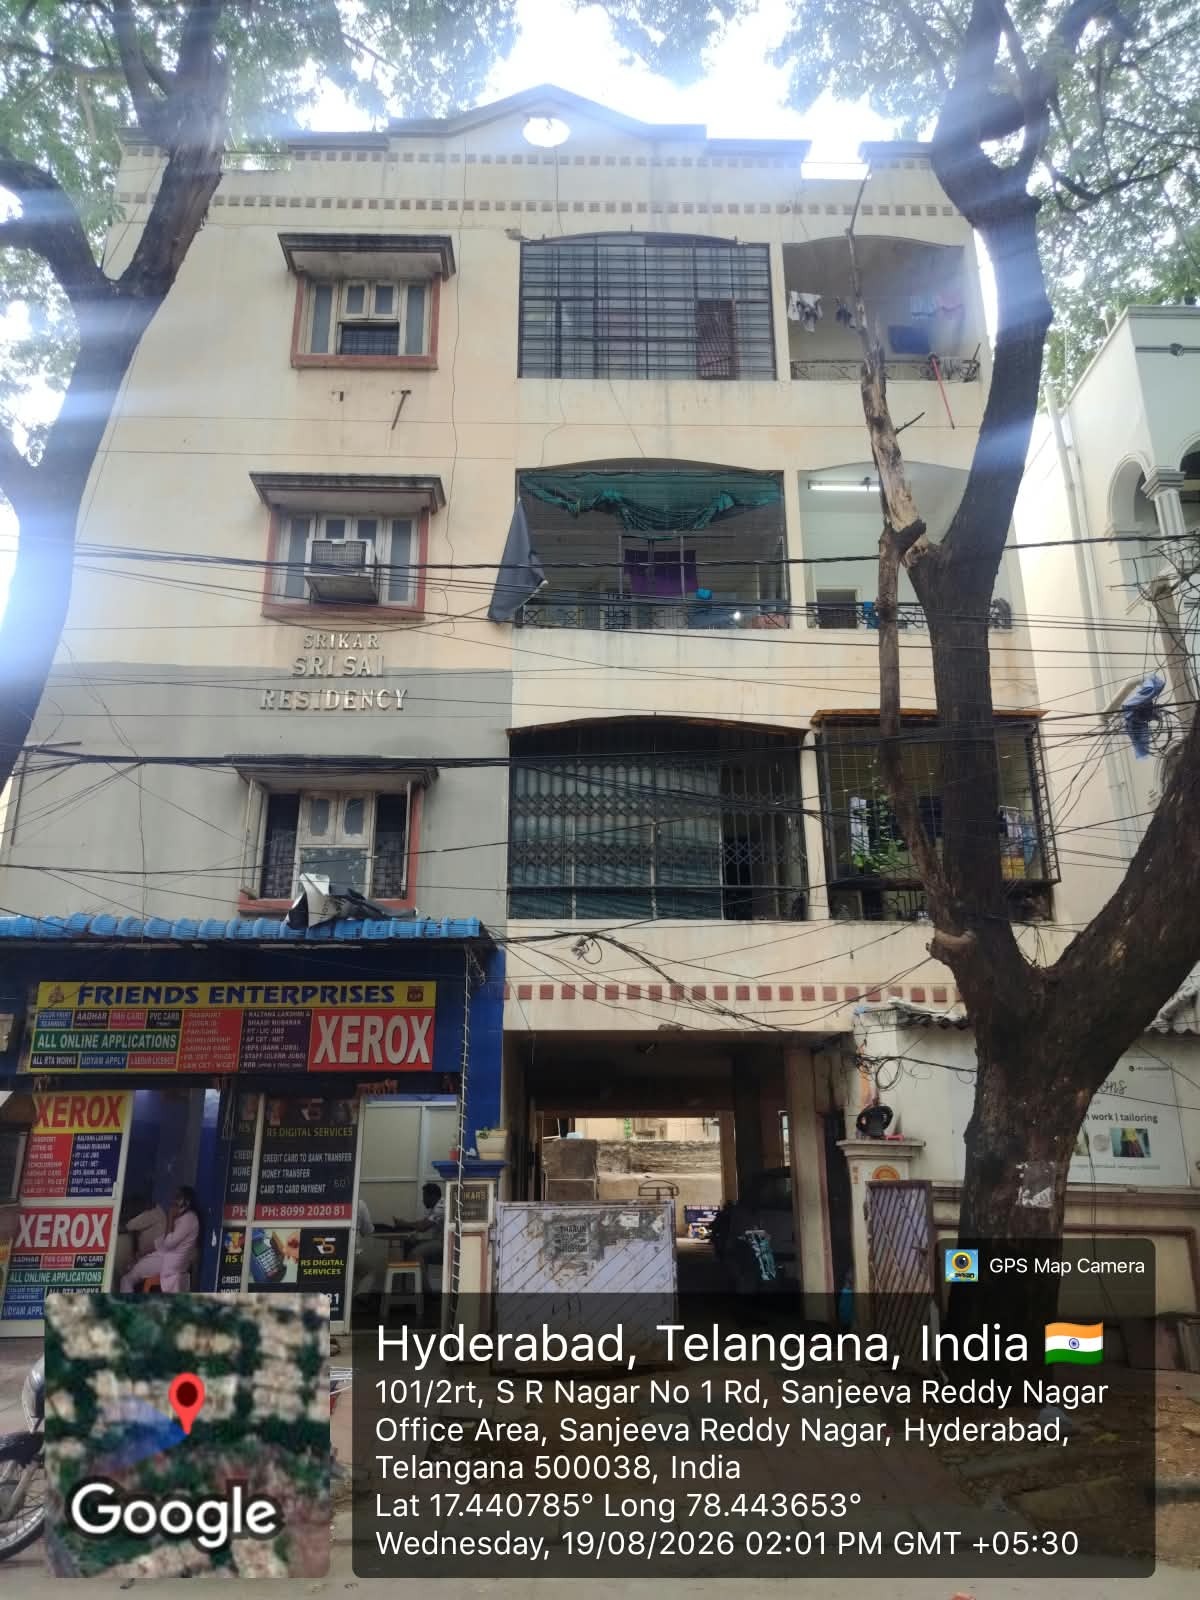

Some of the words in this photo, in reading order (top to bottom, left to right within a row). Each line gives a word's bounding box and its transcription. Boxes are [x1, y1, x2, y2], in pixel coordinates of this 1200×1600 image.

[303, 633, 380, 650] SRIKAR
[292, 655, 335, 678] SRI
[342, 655, 385, 678] SAI
[260, 688, 408, 711] RESIDENCY
[78, 986, 199, 1005] FRIENDS
[208, 986, 395, 1005] ENTERPRISES
[37, 1034, 56, 1048] ALL
[60, 1034, 98, 1048] ONLINE
[101, 1034, 176, 1048] APPLICATIONS
[313, 1015, 432, 1064] XEROX
[81, 1056, 103, 1065] UDYAM
[104, 1056, 125, 1065] APPLY
[33, 1095, 123, 1128] XEROX
[1091, 1113, 1114, 1121] work
[1120, 1114, 1158, 1124] tailoring
[280, 1128, 312, 1137] DIGITAL
[313, 1128, 353, 1137] SERVICES
[233, 1150, 253, 1160] CREDI
[232, 1166, 251, 1176] MONE
[261, 1168, 281, 1178] MONEY
[282, 1168, 311, 1178] TRANSFER
[260, 1184, 274, 1194] CARD
[276, 1184, 283, 1194] TO
[284, 1184, 299, 1194] CARD
[300, 1184, 326, 1194] PAYMENT
[280, 1205, 305, 1216] 8099
[307, 1205, 331, 1216] 2020
[333, 1205, 345, 1216] 81
[15, 1213, 109, 1248] XEROX
[10, 1271, 23, 1282] ALL
[24, 1271, 51, 1282] ONLINE
[52, 1271, 102, 1282] APPLICATIONS
[222, 1276, 241, 1284] CREDI
[27, 1306, 43, 1316] APPL
